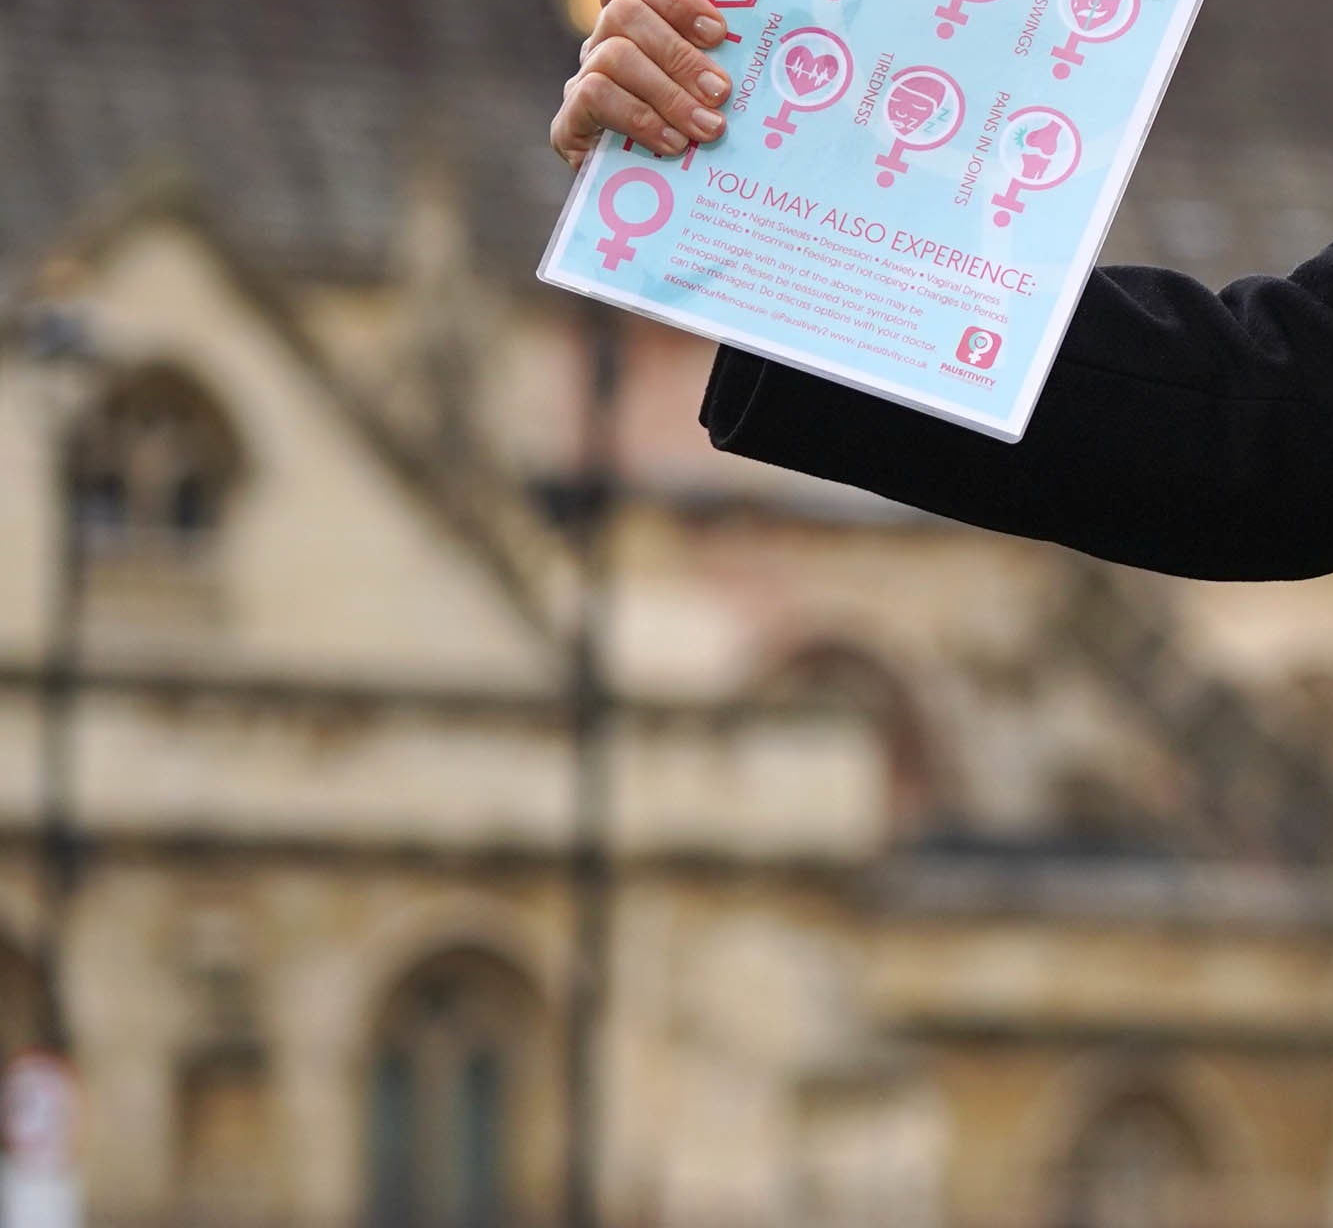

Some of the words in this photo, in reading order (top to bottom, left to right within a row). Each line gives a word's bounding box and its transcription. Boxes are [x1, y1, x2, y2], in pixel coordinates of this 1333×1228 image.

[734, 12, 782, 112] PALPITATIONS
[854, 53, 894, 126] TIREDNESS
[983, 91, 1010, 131] PAINS
[976, 136, 991, 152] IN
[953, 156, 983, 205] JOINTS
[707, 167, 759, 200] YOU
[762, 186, 818, 219] MAY
[820, 209, 887, 244] ALSO
[890, 231, 1035, 294] EXPERIENCE:
[940, 362, 997, 386] PAUSITIVITY
